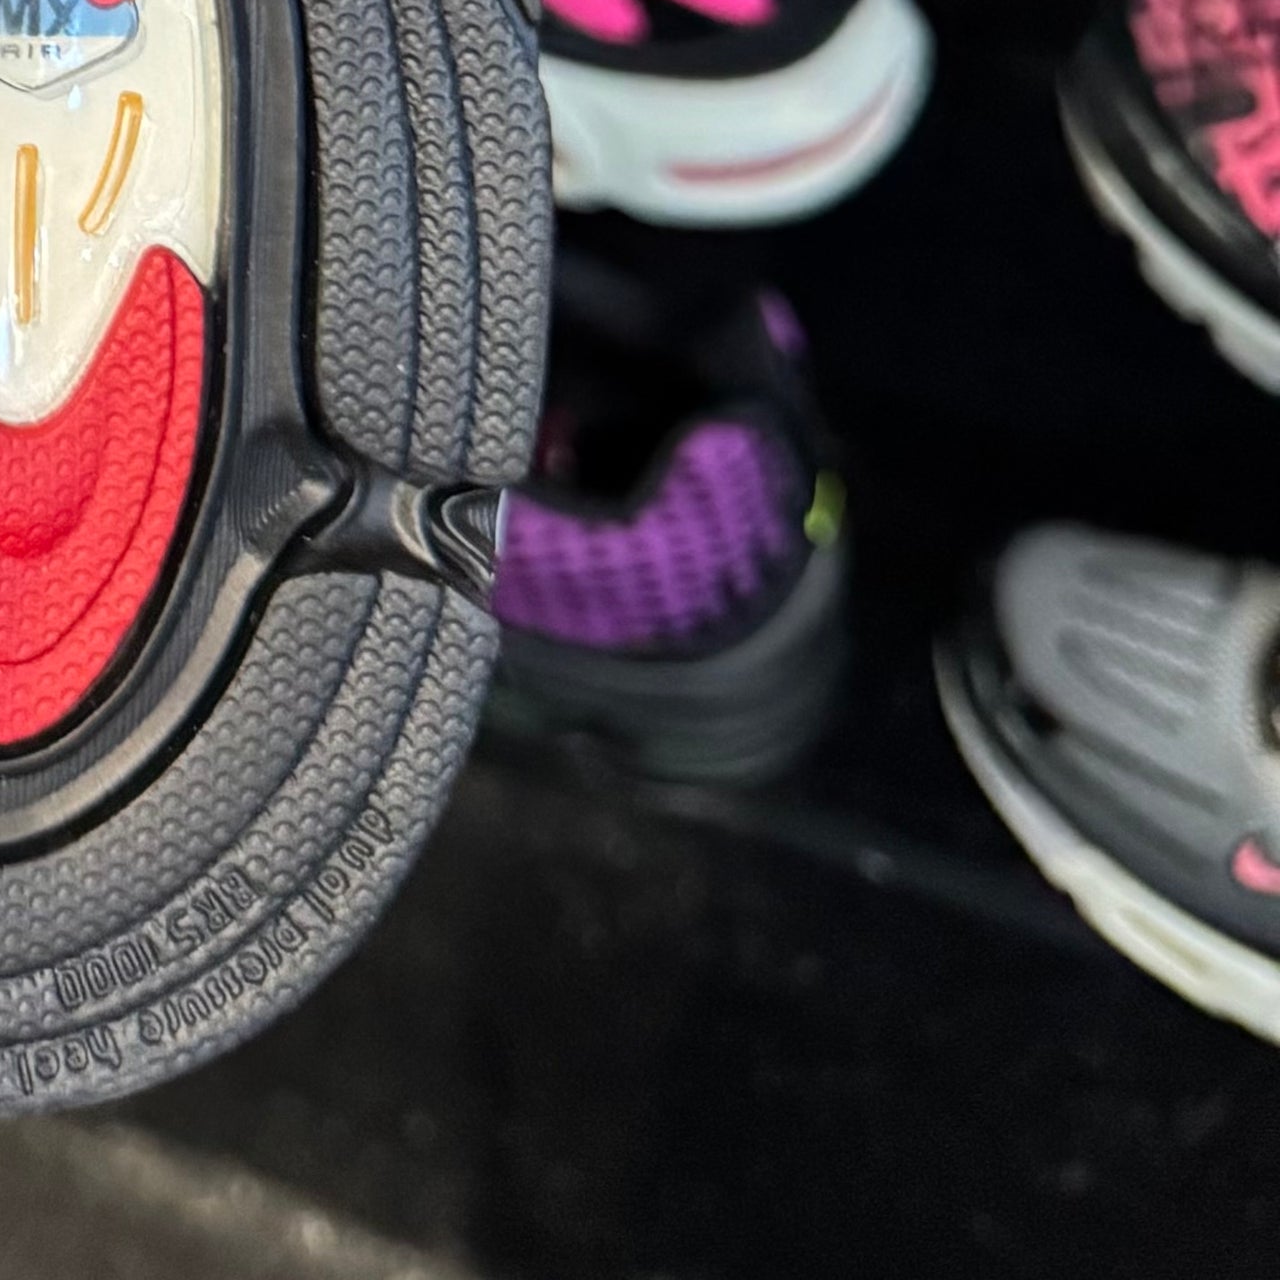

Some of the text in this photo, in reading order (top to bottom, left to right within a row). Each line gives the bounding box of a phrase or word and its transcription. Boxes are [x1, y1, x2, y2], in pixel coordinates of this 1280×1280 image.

[15, 803, 393, 1096] dual pressure heel
[53, 863, 263, 1009] BRS 1000
